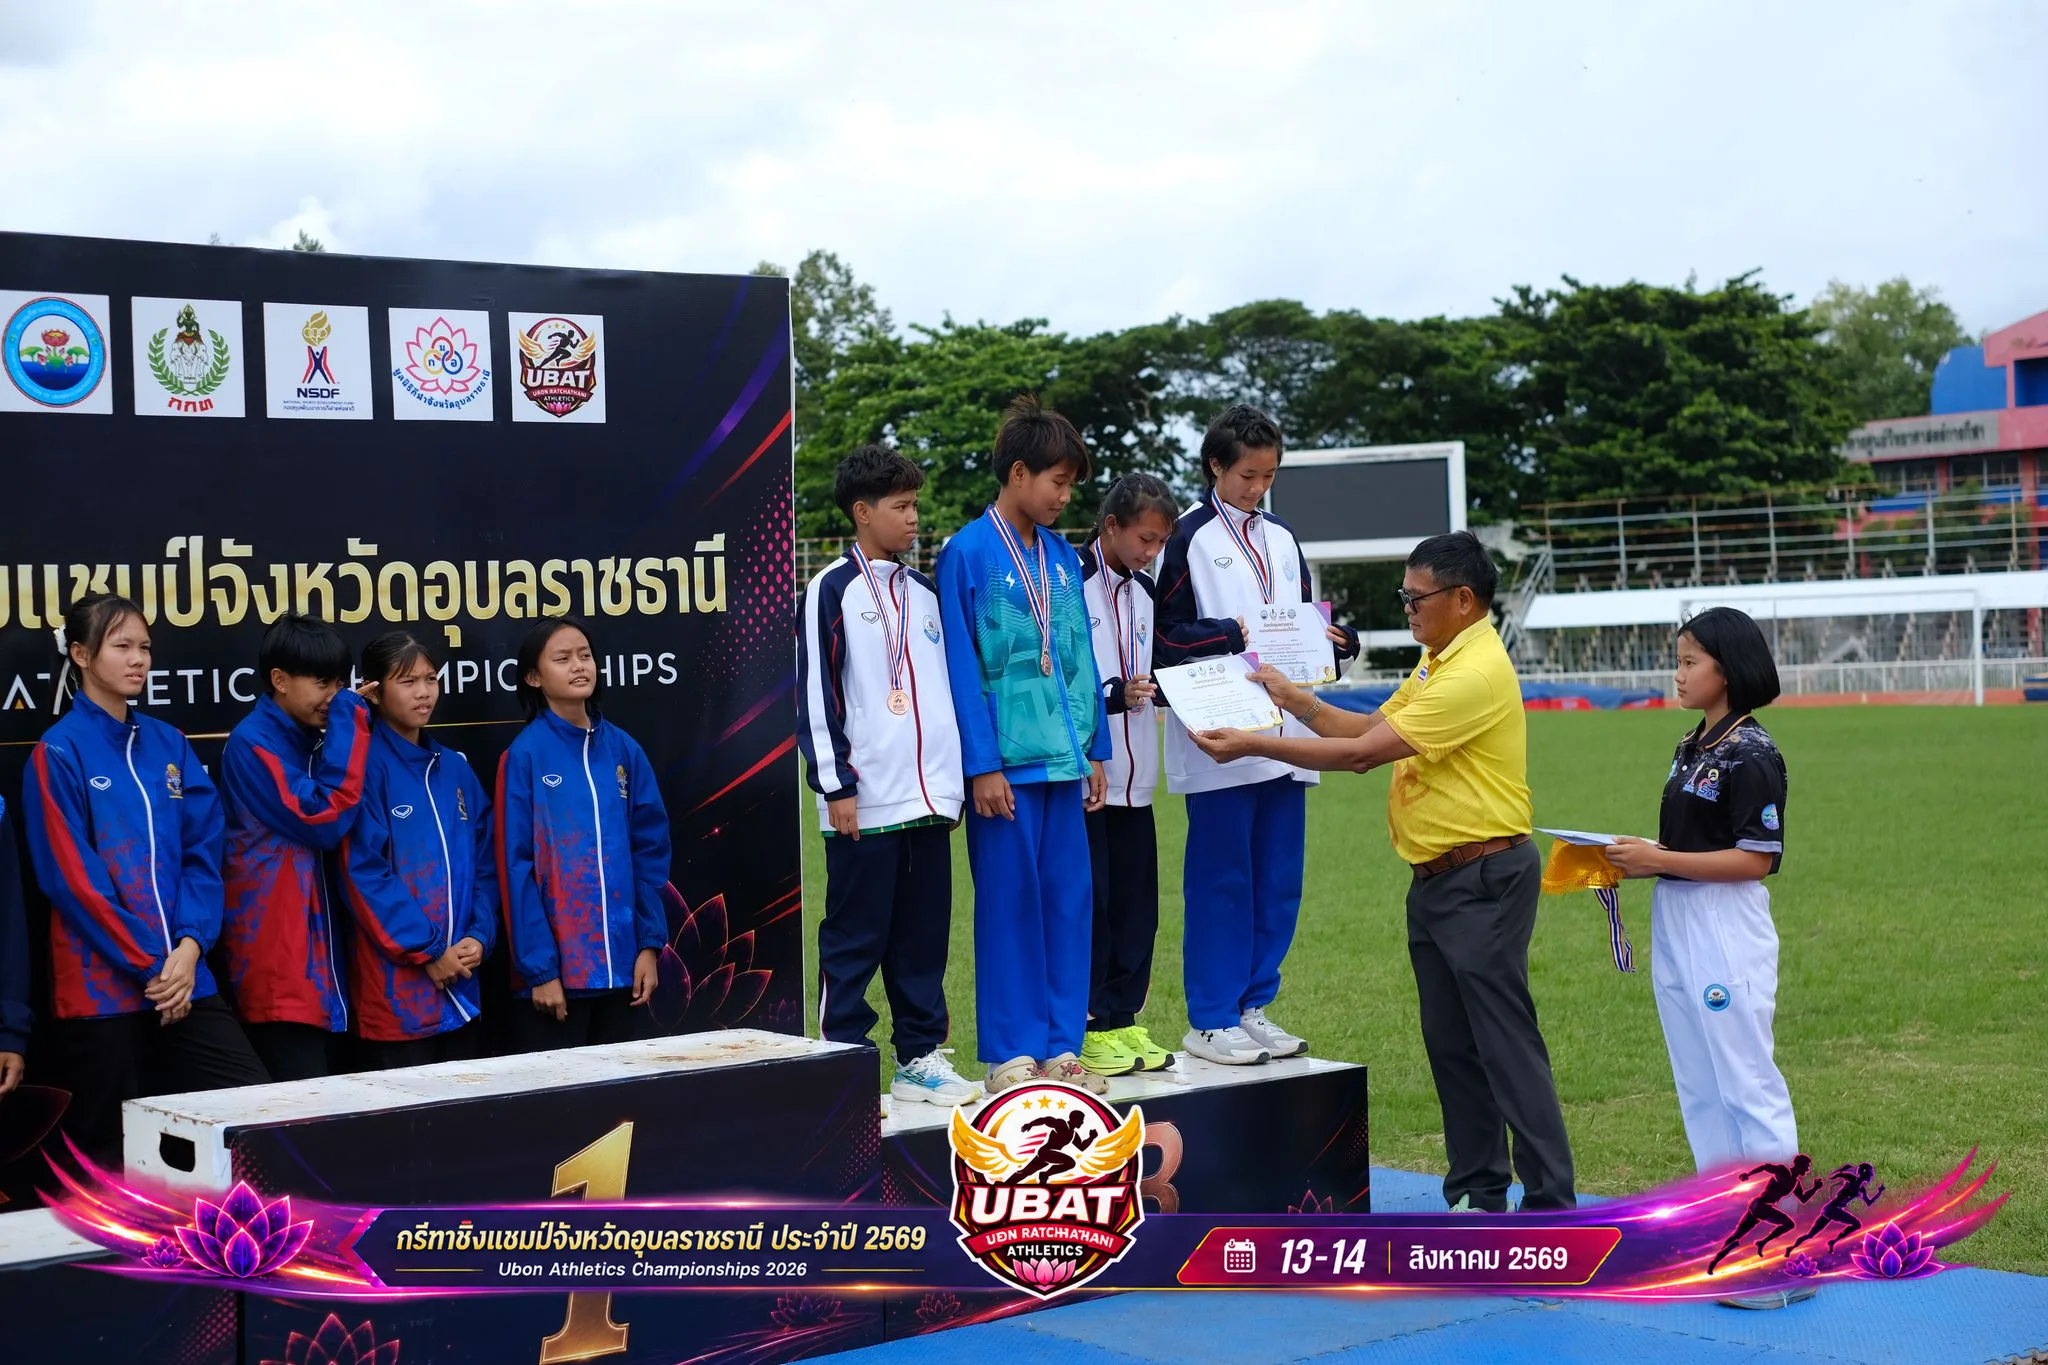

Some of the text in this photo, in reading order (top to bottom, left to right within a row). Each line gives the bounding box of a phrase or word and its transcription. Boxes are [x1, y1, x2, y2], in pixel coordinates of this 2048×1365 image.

[526, 368, 591, 388] UBAT
[297, 388, 340, 398] NSDF
[540, 1122, 634, 1365] 1
